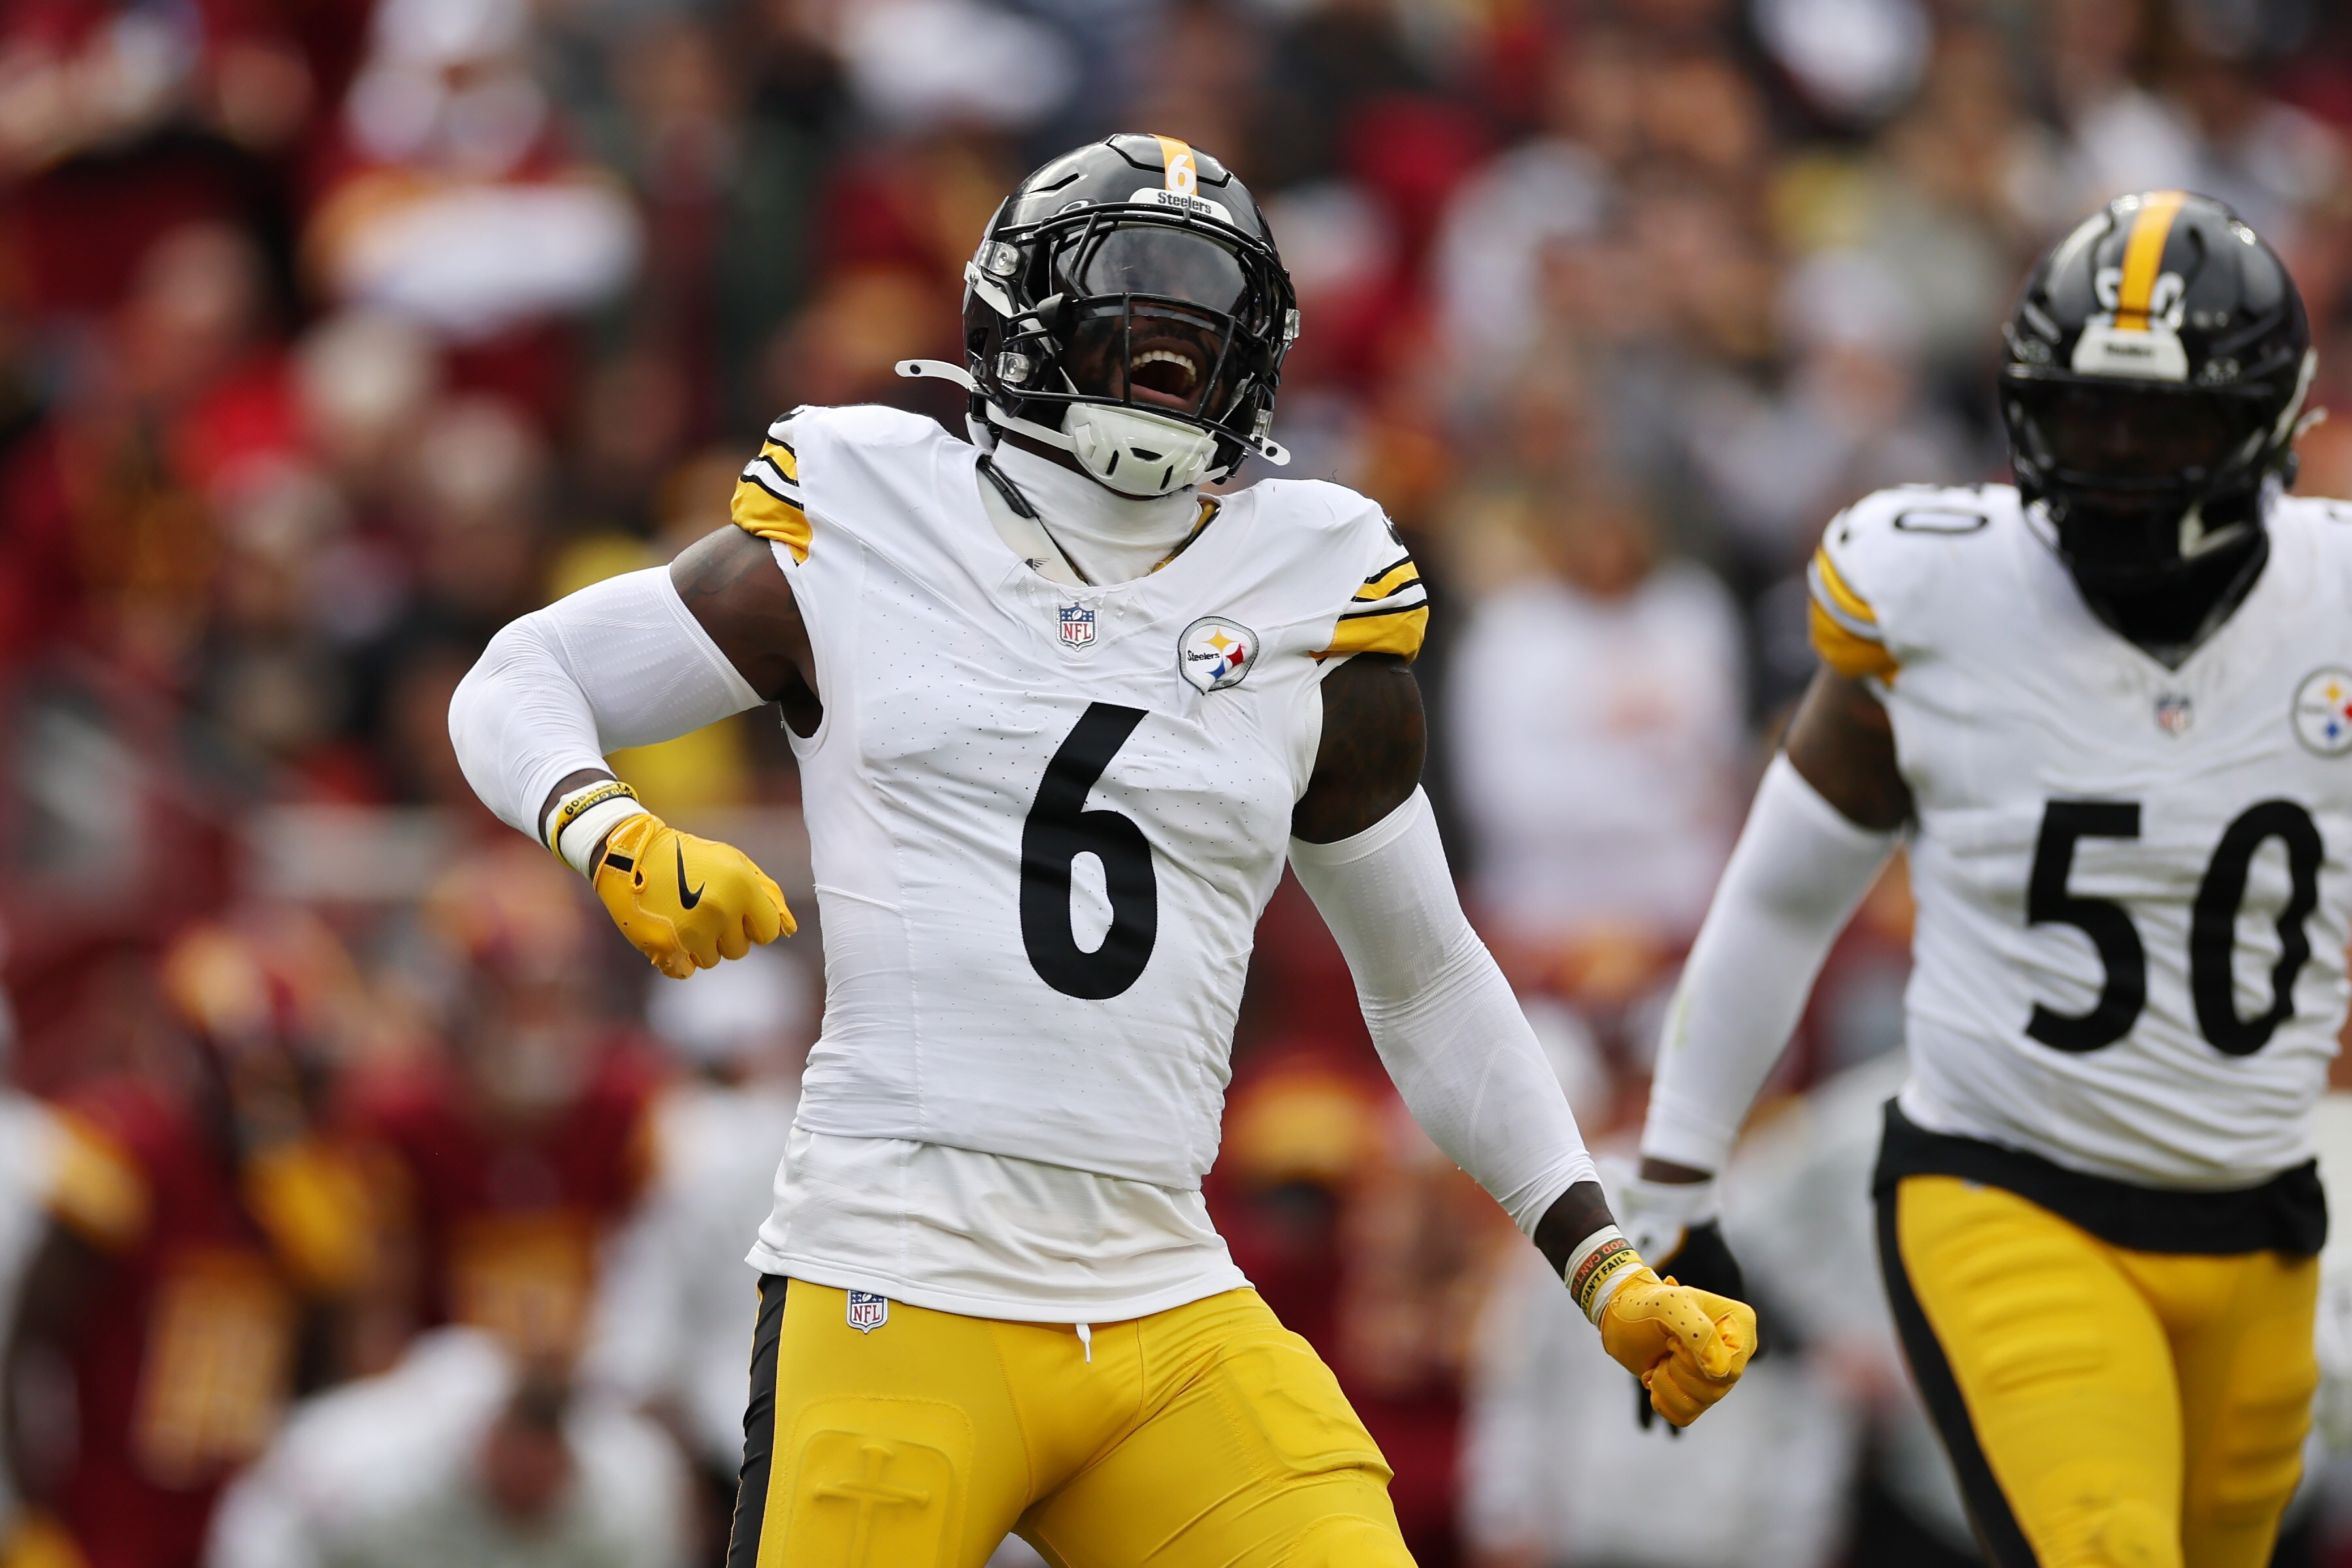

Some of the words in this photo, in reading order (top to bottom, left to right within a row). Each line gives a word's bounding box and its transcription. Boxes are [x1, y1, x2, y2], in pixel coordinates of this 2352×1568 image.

[1167, 154, 1197, 194] 6
[1157, 191, 1212, 214] Steelers
[1063, 622, 1092, 642] NFL
[1186, 649, 1220, 661] Steelers
[1019, 701, 1158, 1000] 6
[2025, 798, 2324, 1057] 50
[1582, 1272, 1601, 1303] CAN'T
[853, 1304, 881, 1324] NFL
